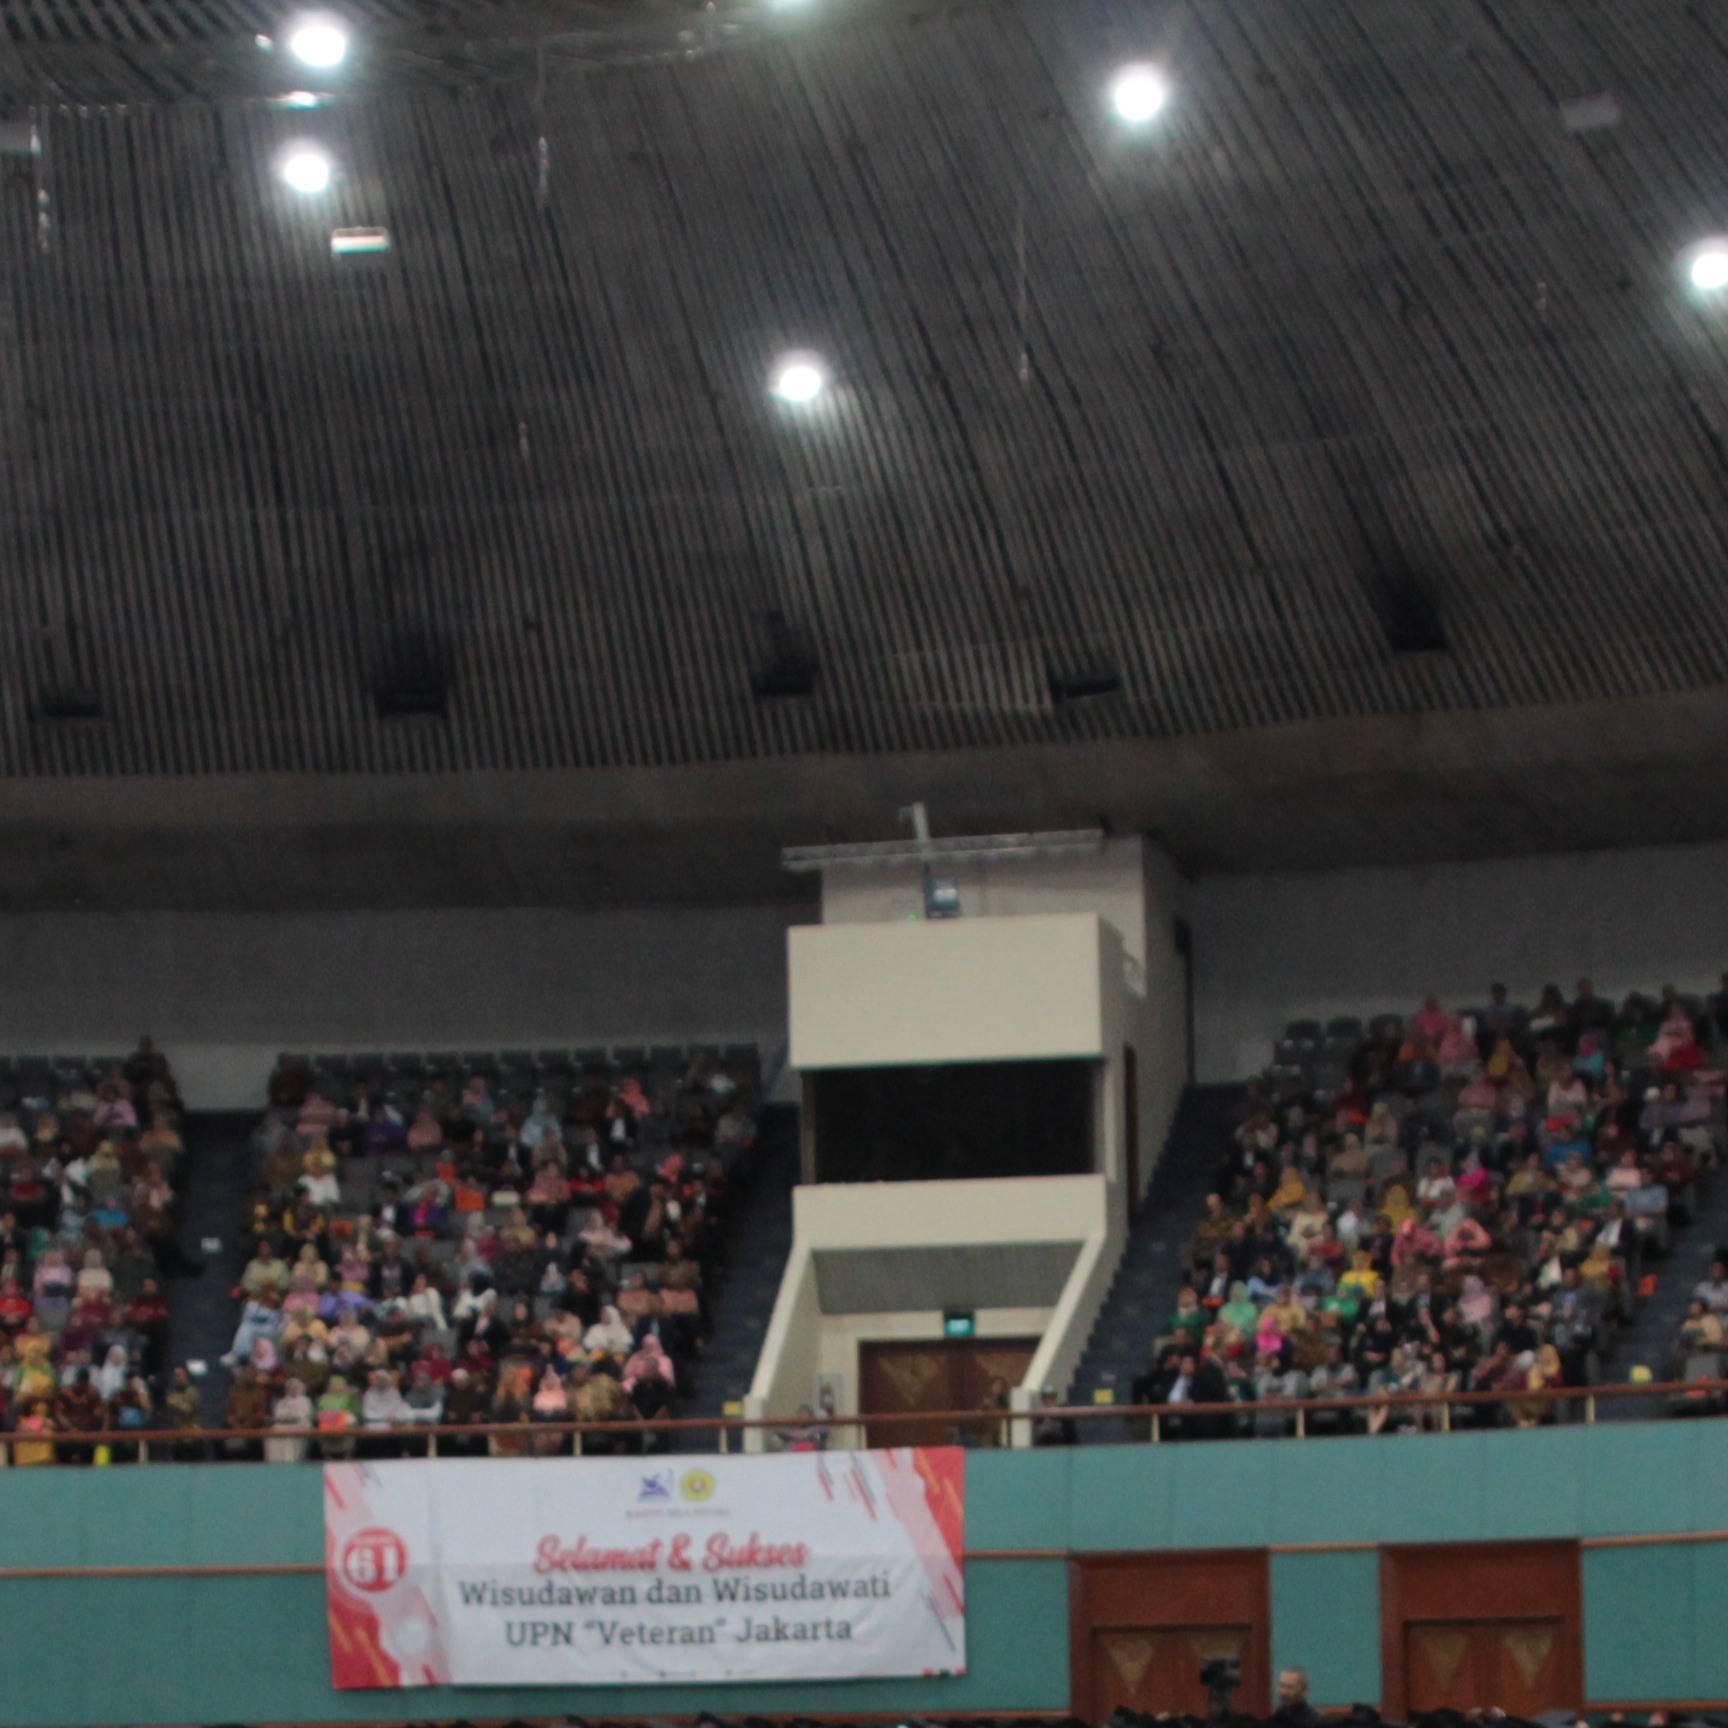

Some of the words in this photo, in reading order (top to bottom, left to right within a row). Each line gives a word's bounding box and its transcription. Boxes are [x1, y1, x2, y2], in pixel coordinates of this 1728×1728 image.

[533, 1533, 662, 1575] Selamat
[703, 1531, 808, 1573] Sukses
[459, 1579, 637, 1608] Wisudawan
[646, 1577, 702, 1605] dan
[712, 1569, 891, 1603] Wisudawati
[504, 1619, 575, 1647] UPN
[735, 1615, 853, 1644] Jakarta
